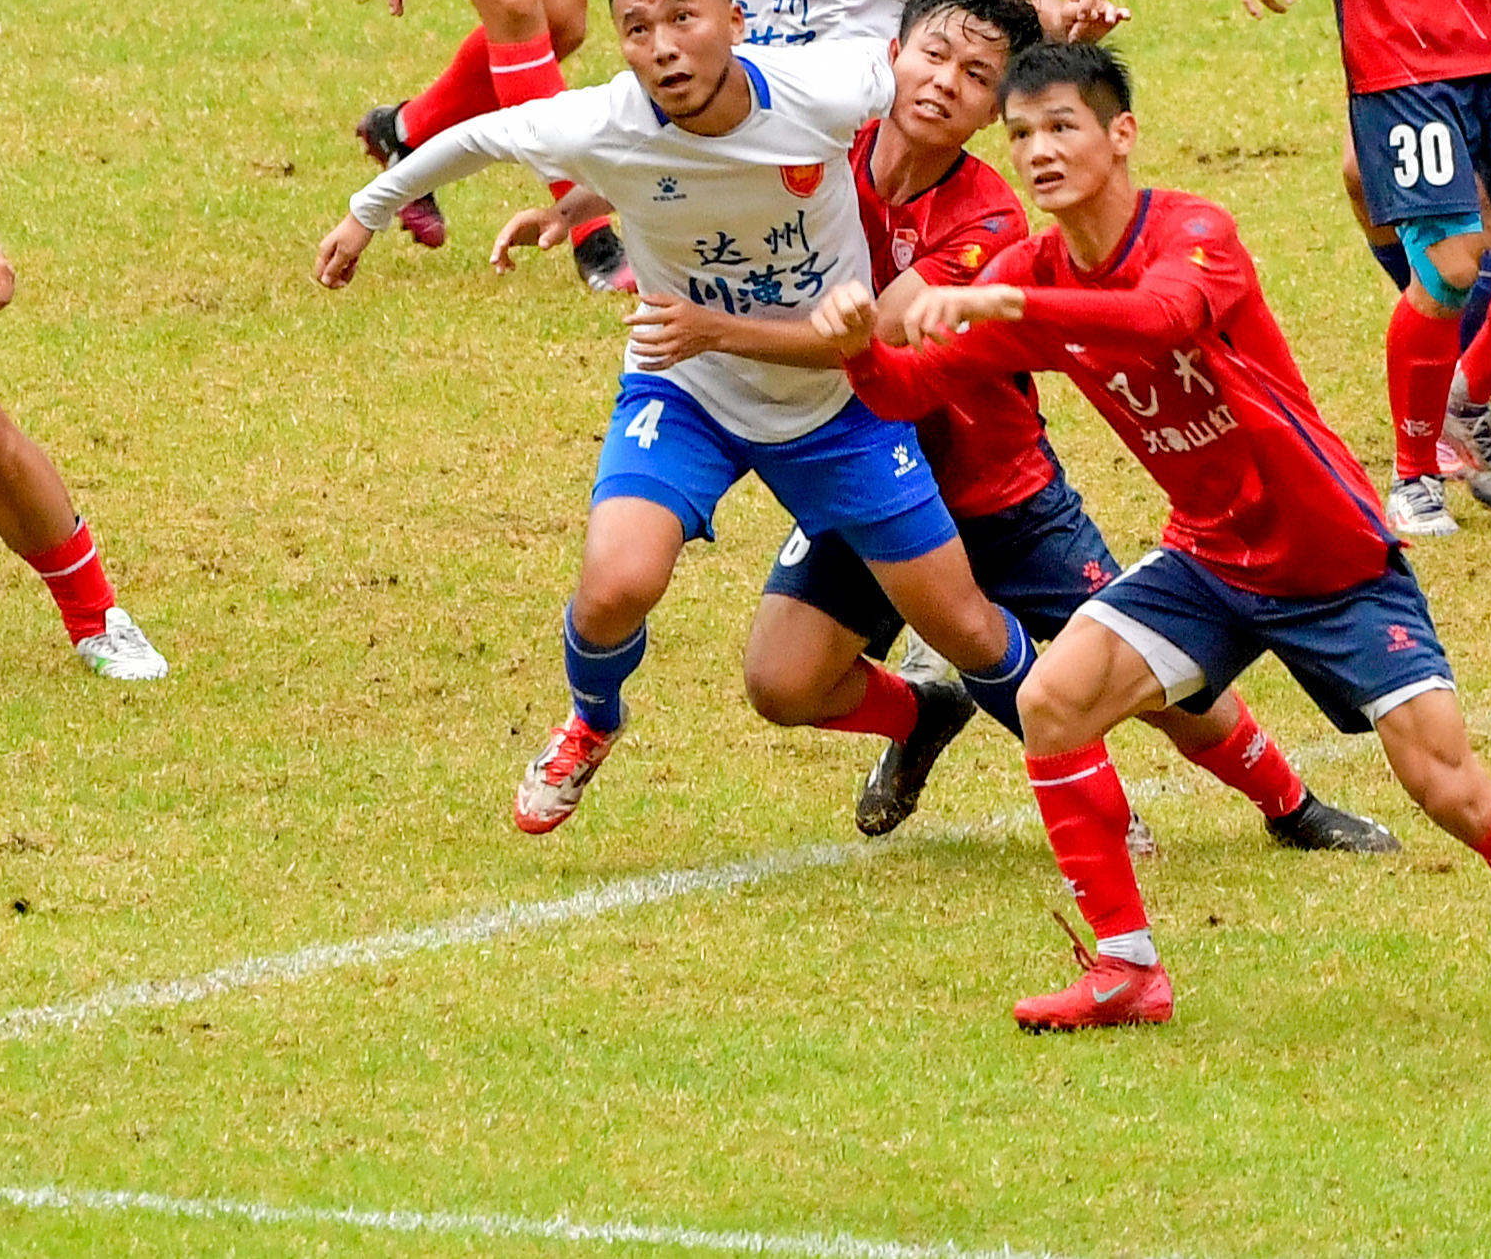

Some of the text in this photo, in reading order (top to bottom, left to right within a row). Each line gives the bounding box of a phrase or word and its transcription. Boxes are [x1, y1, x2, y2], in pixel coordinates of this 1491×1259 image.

[1389, 122, 1455, 188] 30
[692, 210, 810, 266] 达州
[624, 398, 665, 450] 4
